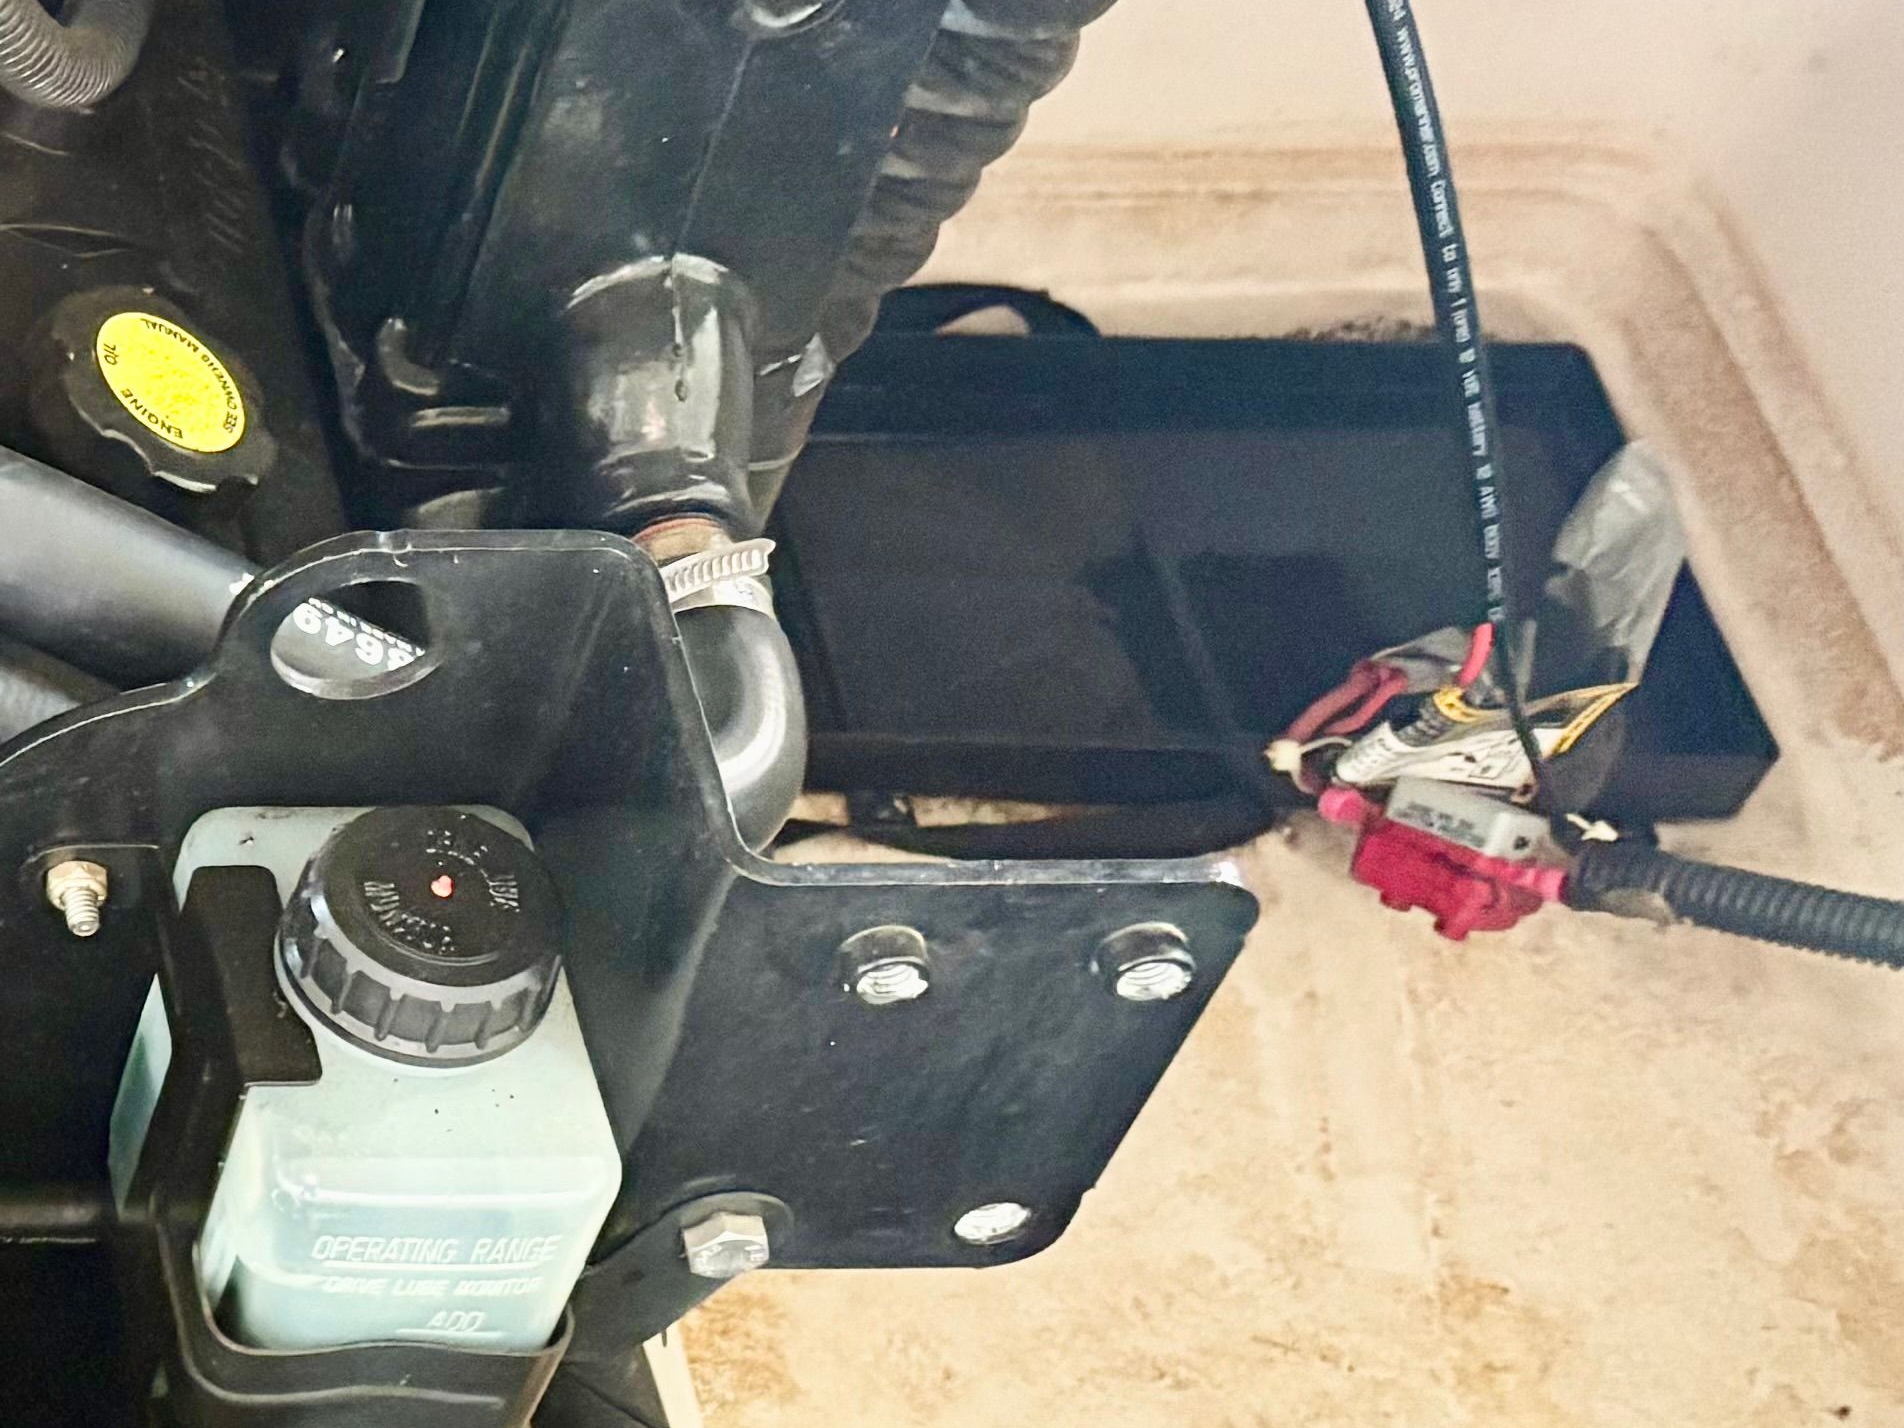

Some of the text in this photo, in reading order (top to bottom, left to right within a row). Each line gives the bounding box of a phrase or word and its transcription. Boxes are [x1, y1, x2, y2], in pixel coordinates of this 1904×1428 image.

[121, 387, 184, 440] ENGINE
[311, 1235, 563, 1263] OPERATING RANGE
[426, 1310, 486, 1332] ADD
